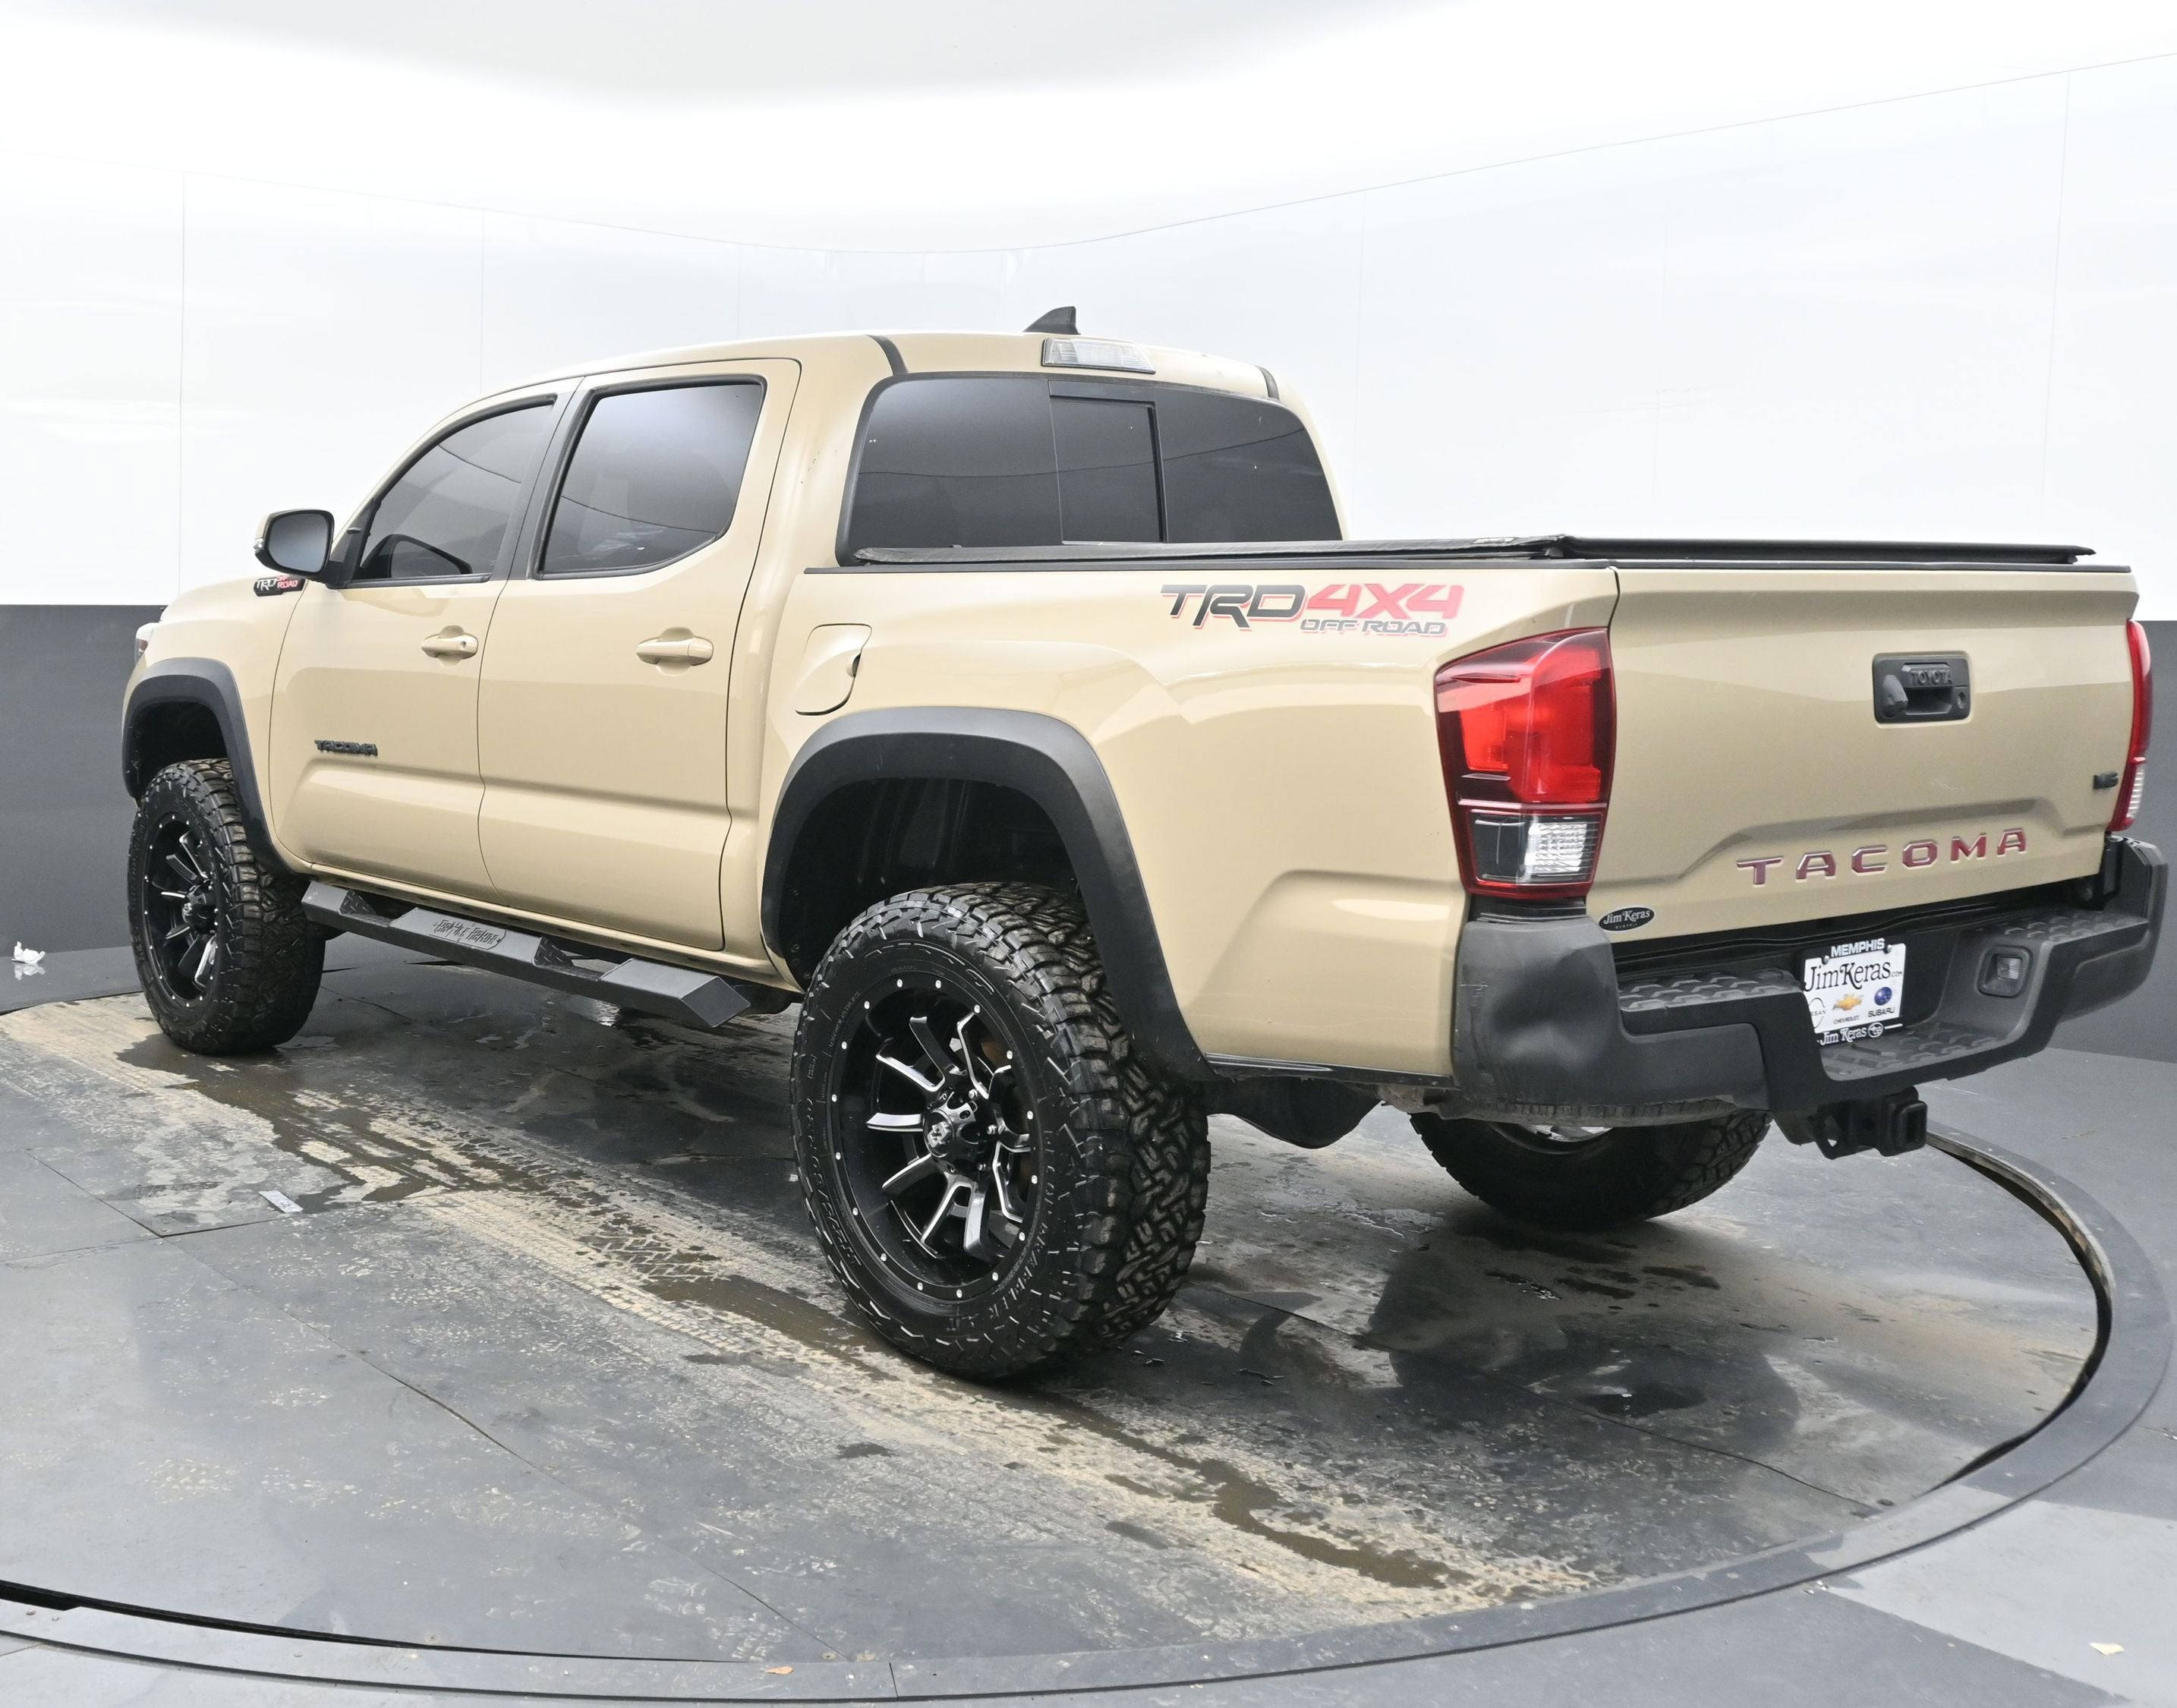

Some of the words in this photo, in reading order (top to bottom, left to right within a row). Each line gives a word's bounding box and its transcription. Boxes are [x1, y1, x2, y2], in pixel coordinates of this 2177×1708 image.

[257, 579, 277, 591] TRD
[1161, 585, 1307, 631] TRD
[1300, 619, 1357, 634] OFF
[1362, 619, 1448, 638] ROAD
[1910, 670, 1953, 685] TOYOTA
[1735, 827, 2028, 888] TACOMA
[1603, 913, 1622, 925] Jim
[1622, 910, 1650, 922] Keras
[1830, 938, 1886, 958] MEMPHIS
[1867, 1007, 1895, 1018] SUBARU
[1819, 1031, 1839, 1046] Jim
[1840, 1027, 1868, 1043] Keras
